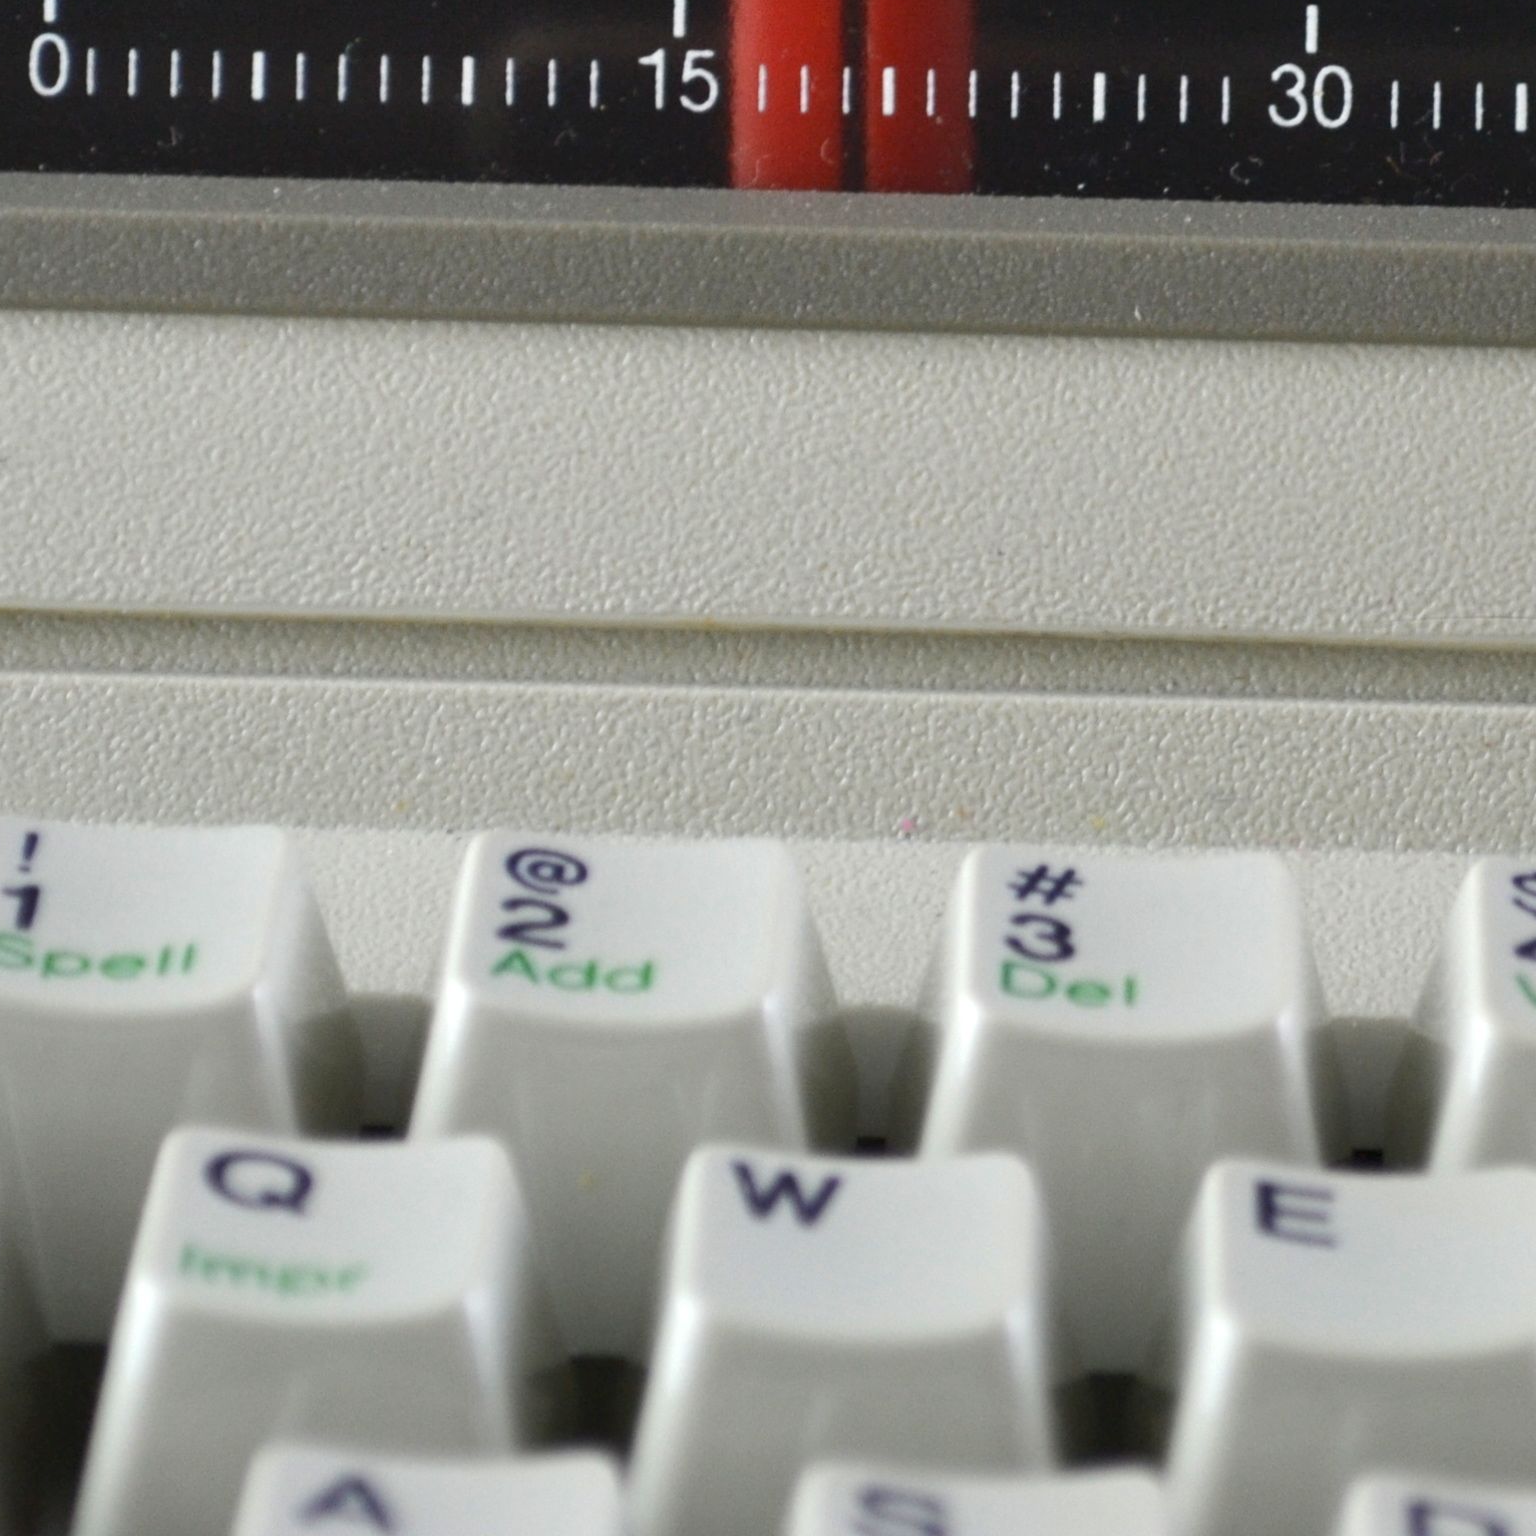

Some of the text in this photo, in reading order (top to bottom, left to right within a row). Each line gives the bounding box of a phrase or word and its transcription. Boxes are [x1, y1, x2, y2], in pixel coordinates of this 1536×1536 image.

[28, 32, 70, 97] 0
[638, 48, 719, 113] 15
[1268, 62, 1353, 129] 30
[18, 831, 40, 873] !
[504, 848, 590, 895] @
[1, 884, 41, 931] 1
[1008, 864, 1085, 906] #
[497, 897, 570, 950] 2
[1004, 913, 1078, 963] 3
[490, 949, 659, 994] Add
[1000, 960, 1139, 1007] Del
[203, 1149, 315, 1215] Q
[730, 1161, 843, 1228] W
[1254, 1180, 1338, 1249] E
